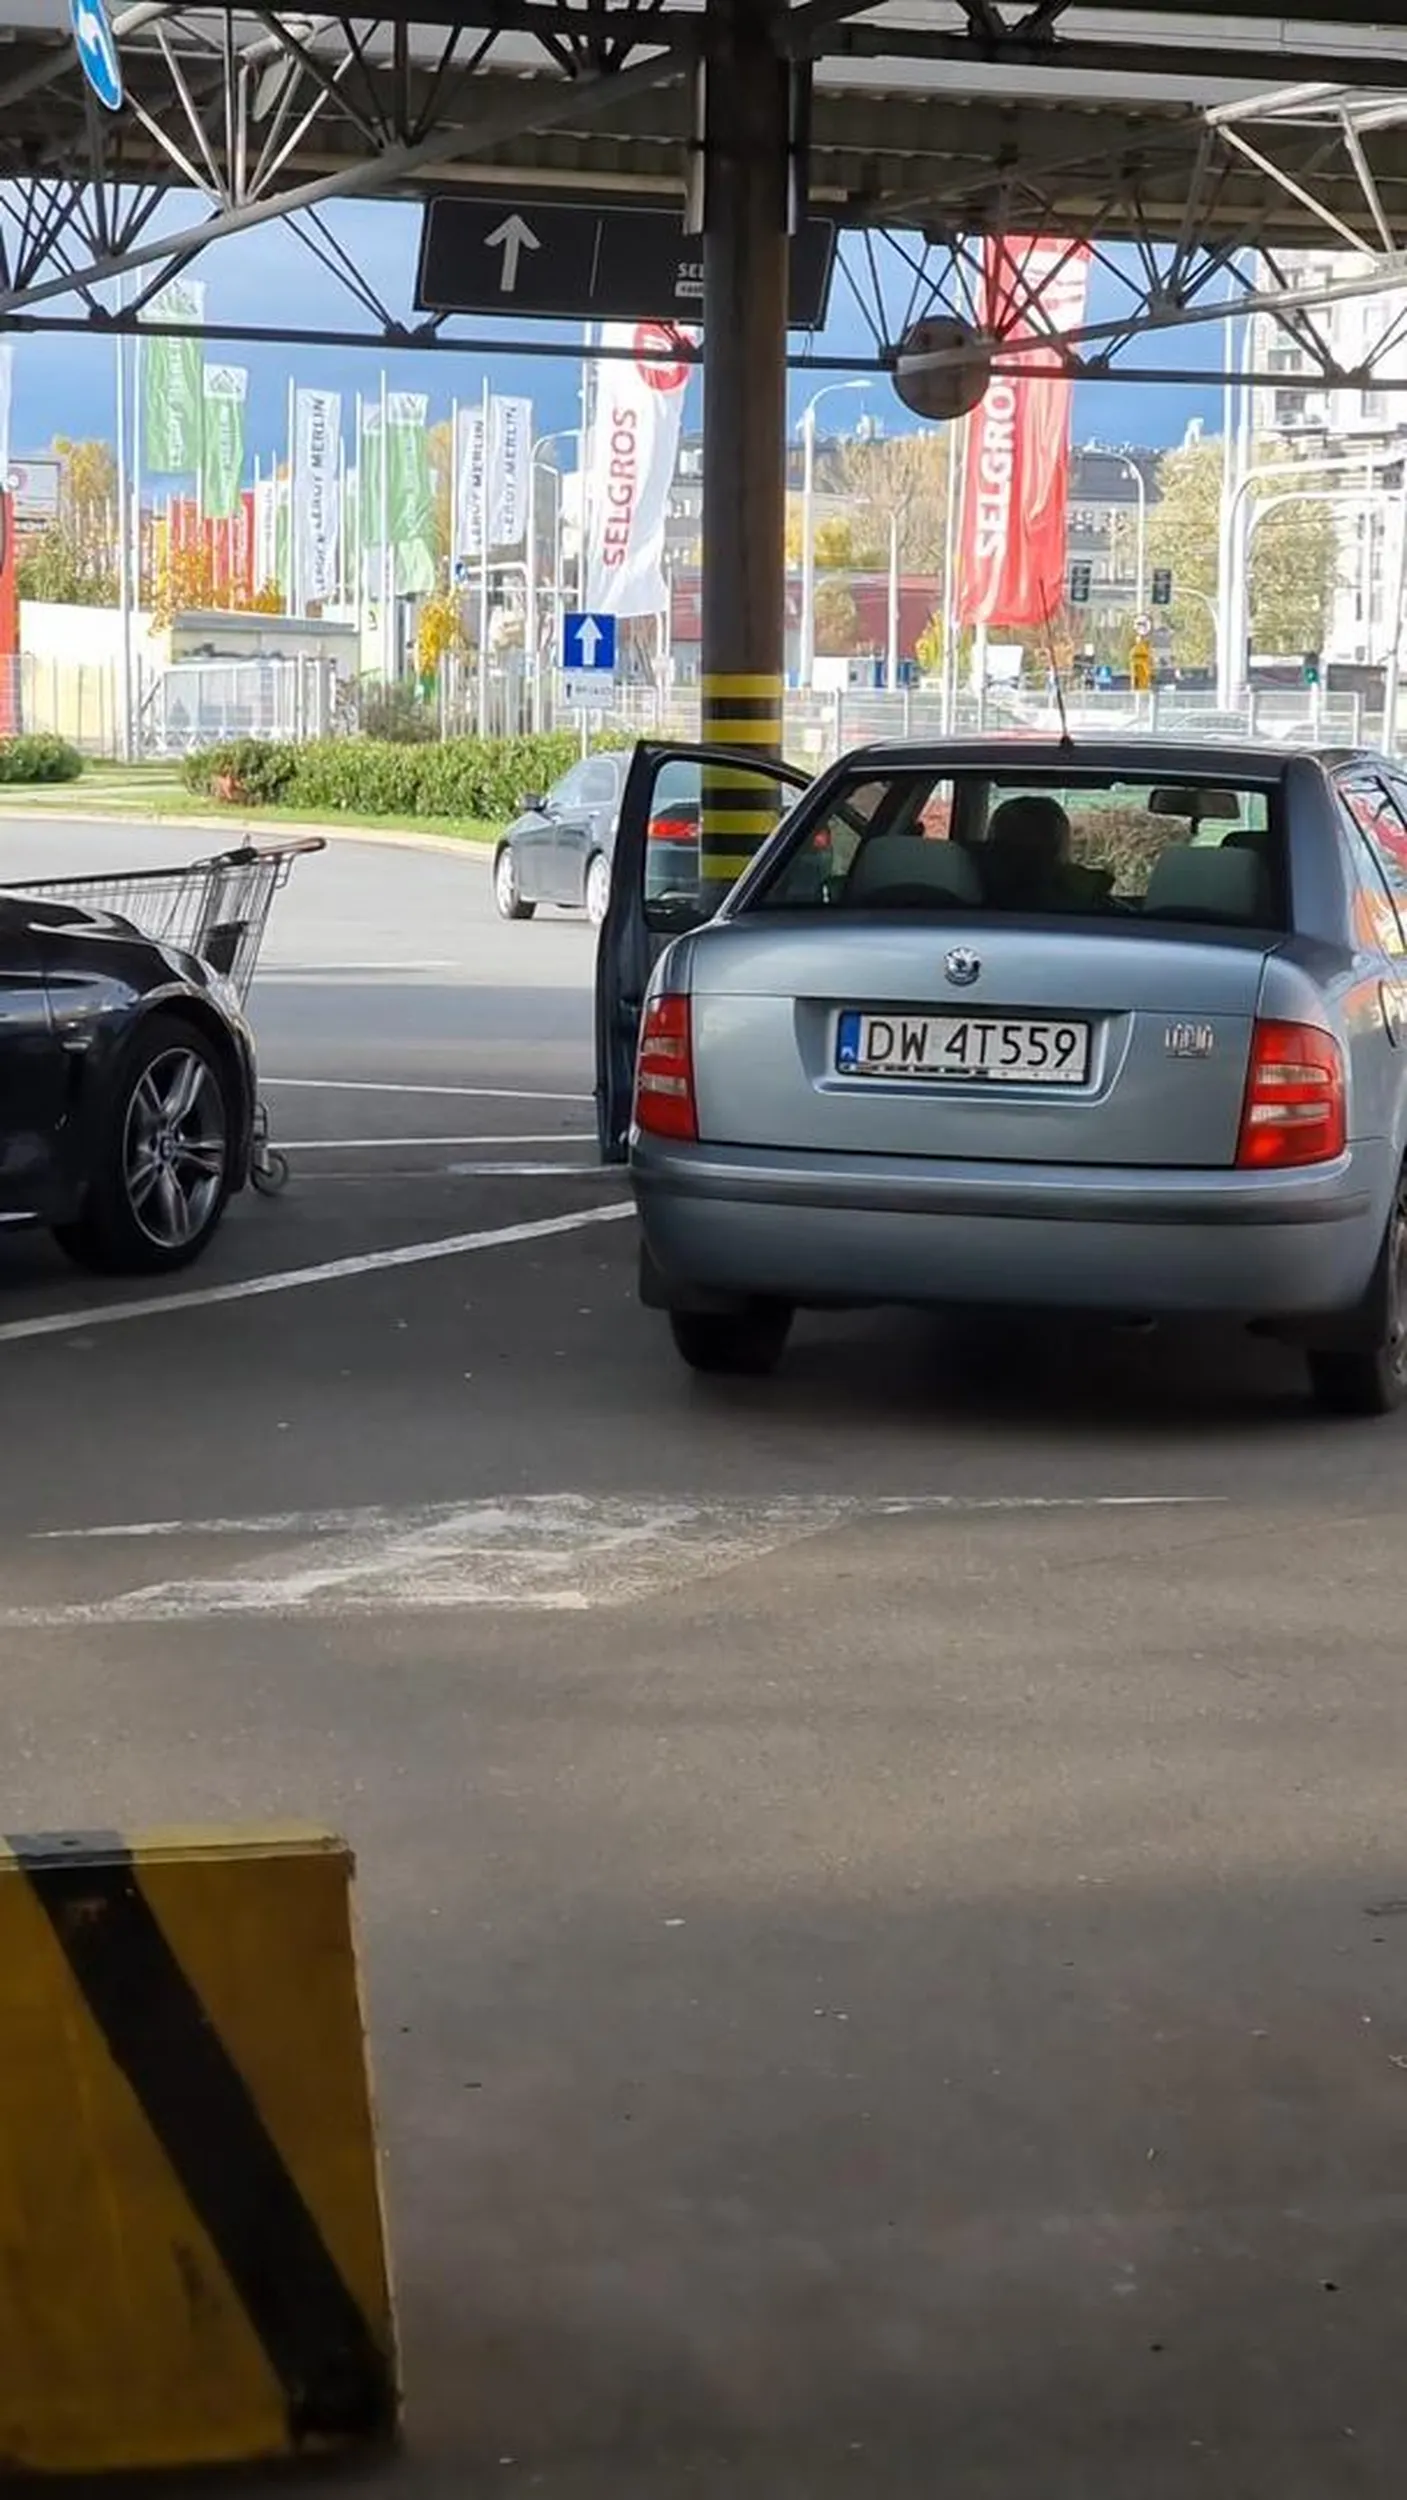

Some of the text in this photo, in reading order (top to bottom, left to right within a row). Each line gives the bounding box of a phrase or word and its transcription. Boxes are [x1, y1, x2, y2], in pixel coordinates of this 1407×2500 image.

[310, 397, 326, 469] MERLIN
[471, 420, 484, 488] MERLIN
[603, 408, 637, 567] SELGROS
[867, 1020, 1077, 1068] DW 4T559
